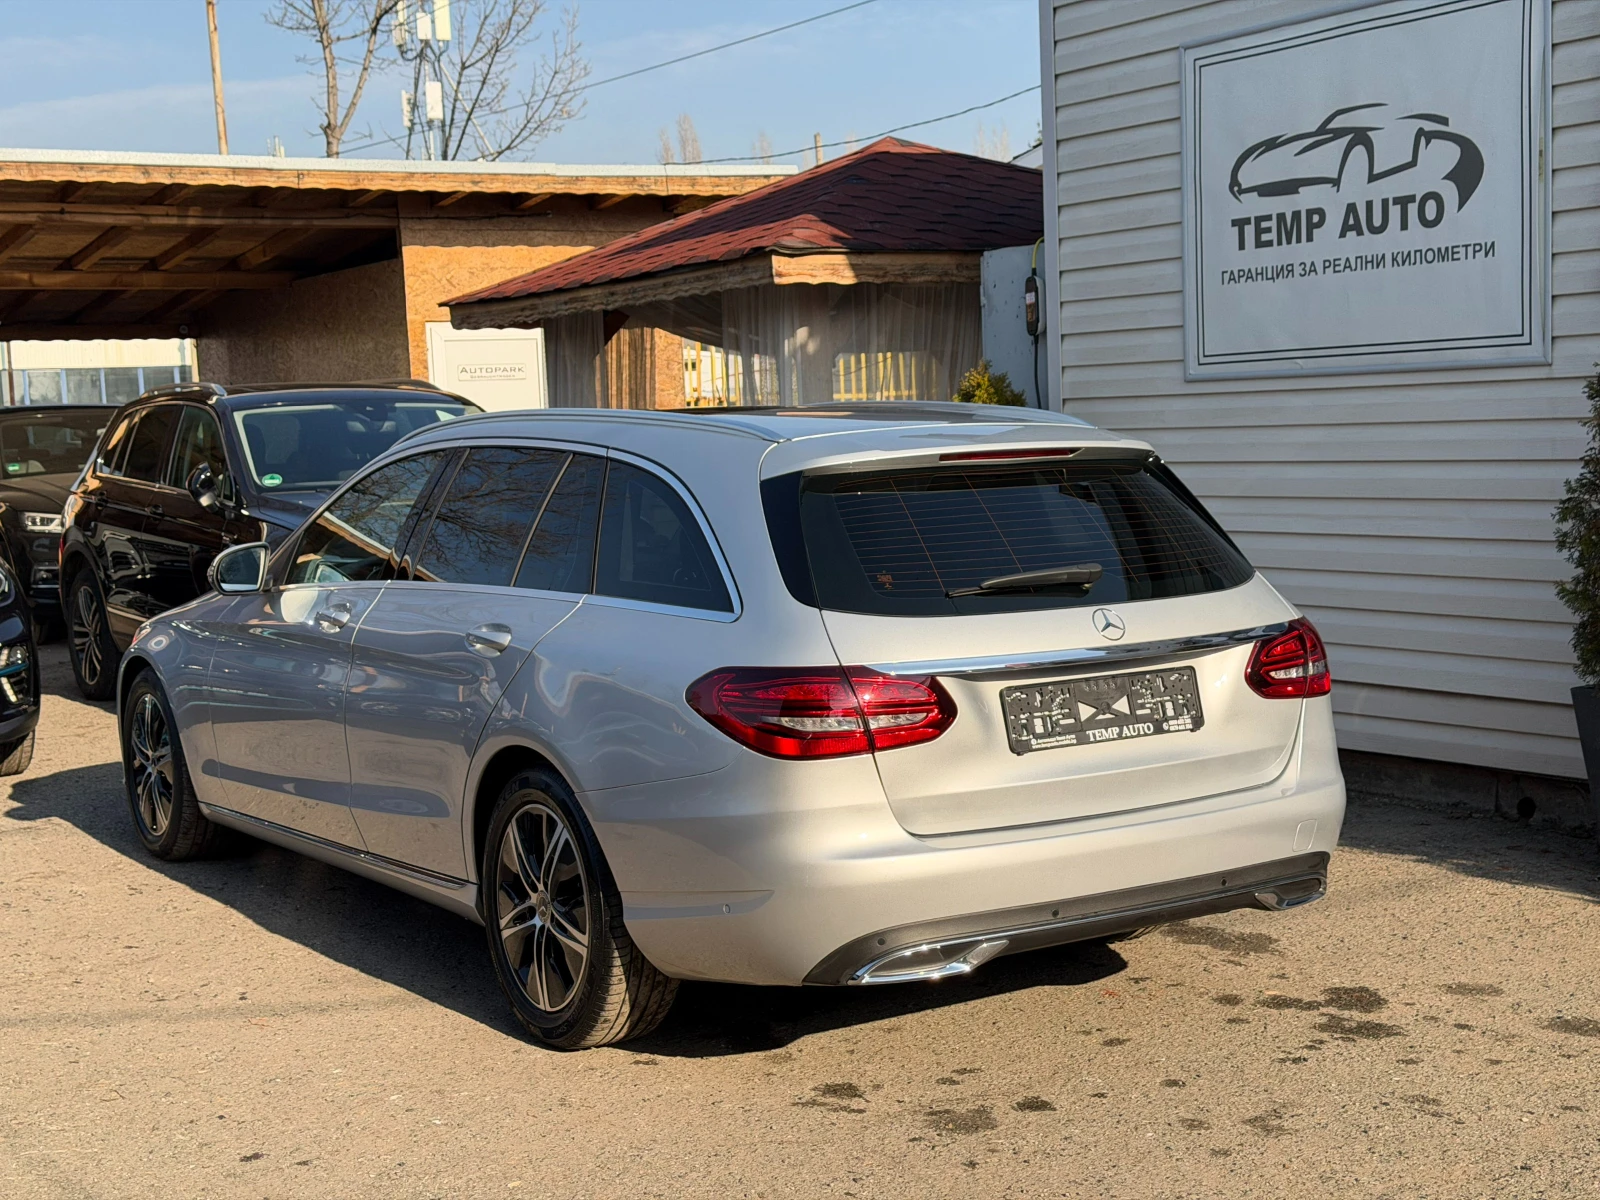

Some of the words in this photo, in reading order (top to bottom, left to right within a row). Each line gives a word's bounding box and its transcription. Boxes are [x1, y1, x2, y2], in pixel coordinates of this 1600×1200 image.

[1231, 206, 1326, 251] TEMP
[1338, 191, 1445, 239] AUTO
[1221, 263, 1295, 286] ГАРАНЦИЯ
[1298, 261, 1318, 278] ЗА
[1322, 253, 1386, 275] РЕАЛНИ
[1391, 241, 1496, 268] КИЛОМЕТРИ
[1086, 727, 1120, 741] TEMP
[1122, 722, 1154, 737] AUTO
